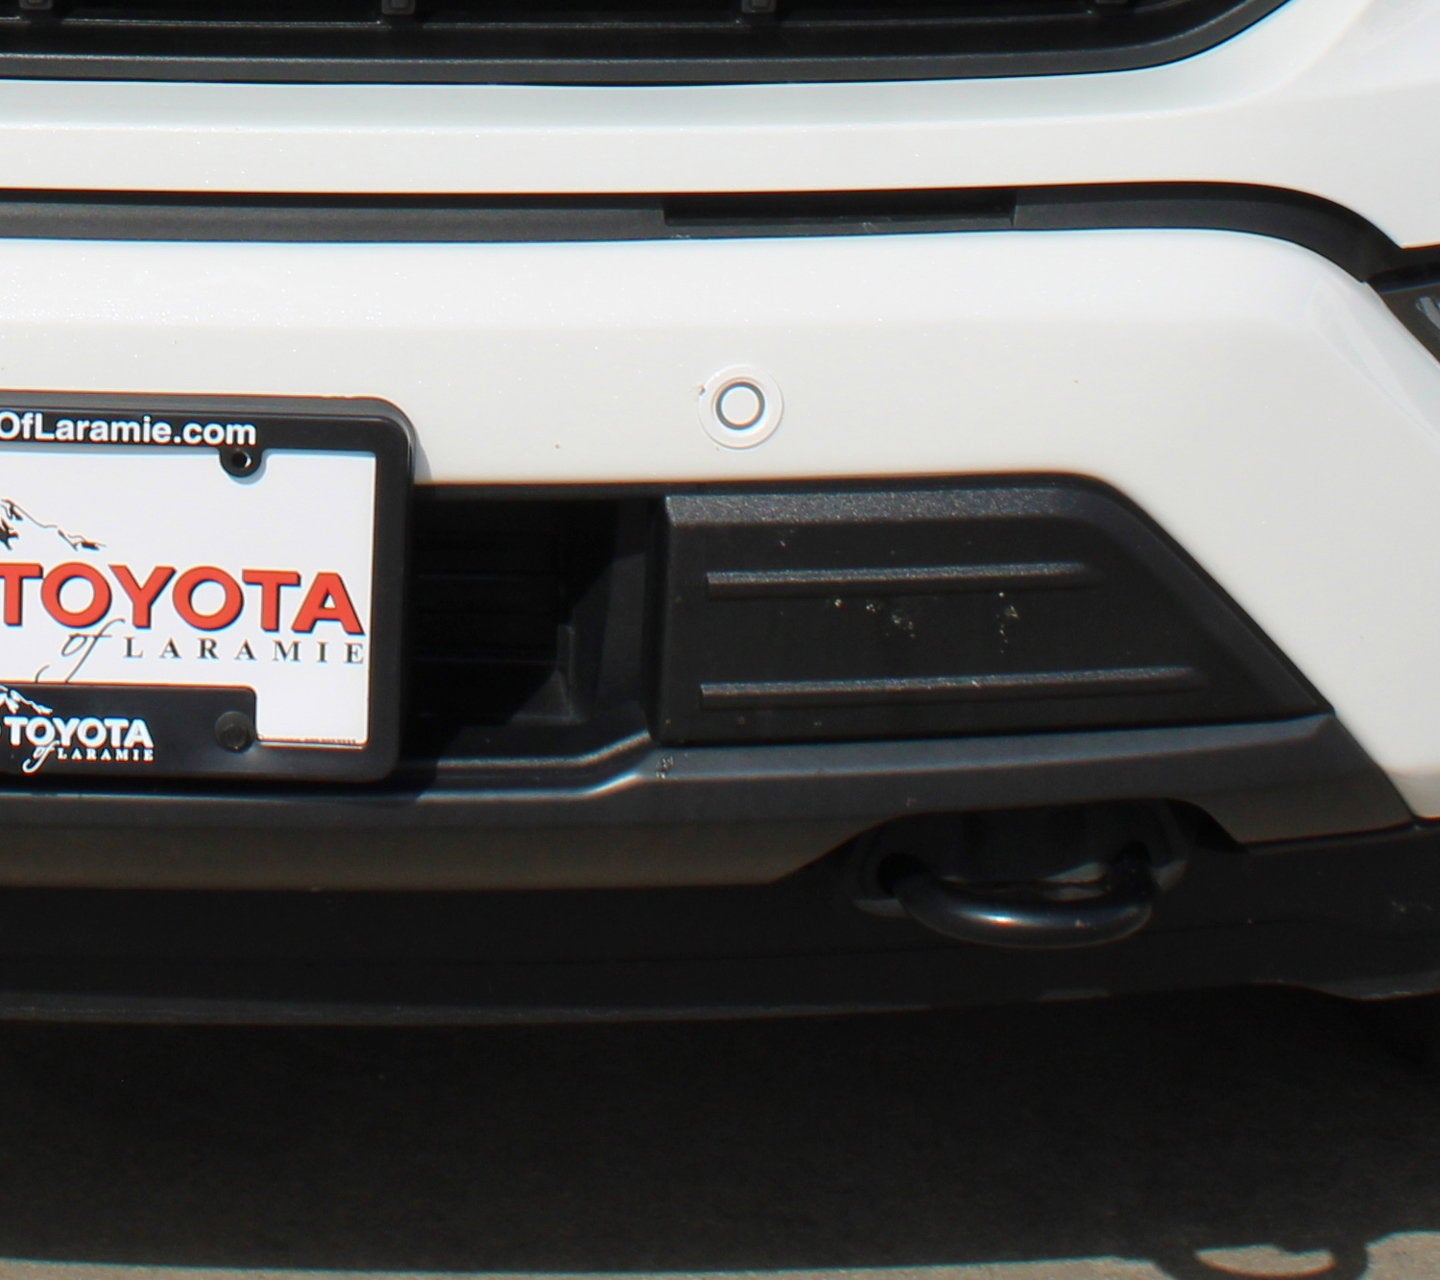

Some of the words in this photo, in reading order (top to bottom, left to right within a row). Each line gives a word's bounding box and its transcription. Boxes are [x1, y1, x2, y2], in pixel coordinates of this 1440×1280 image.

[34, 618, 126, 683] of
[122, 636, 365, 665] LARAMIE
[3, 716, 155, 749] TOYOTA
[22, 740, 60, 774] of
[57, 747, 155, 762] LARAMIE
